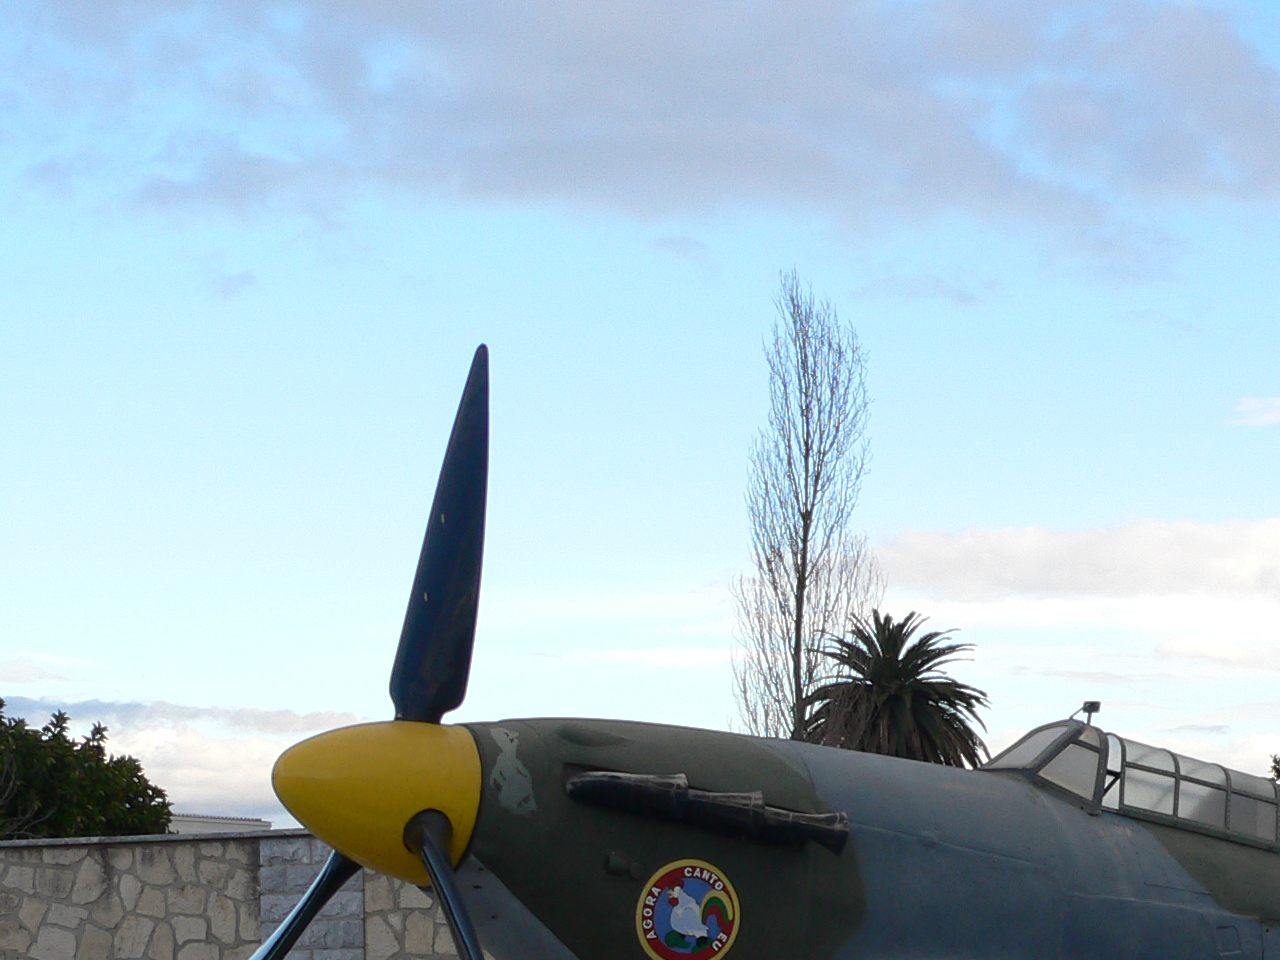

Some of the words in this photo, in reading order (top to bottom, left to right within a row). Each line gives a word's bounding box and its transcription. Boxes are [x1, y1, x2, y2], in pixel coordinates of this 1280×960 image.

[642, 885, 662, 940] AGORA
[684, 867, 725, 892] CANTO
[711, 932, 728, 952] EU
